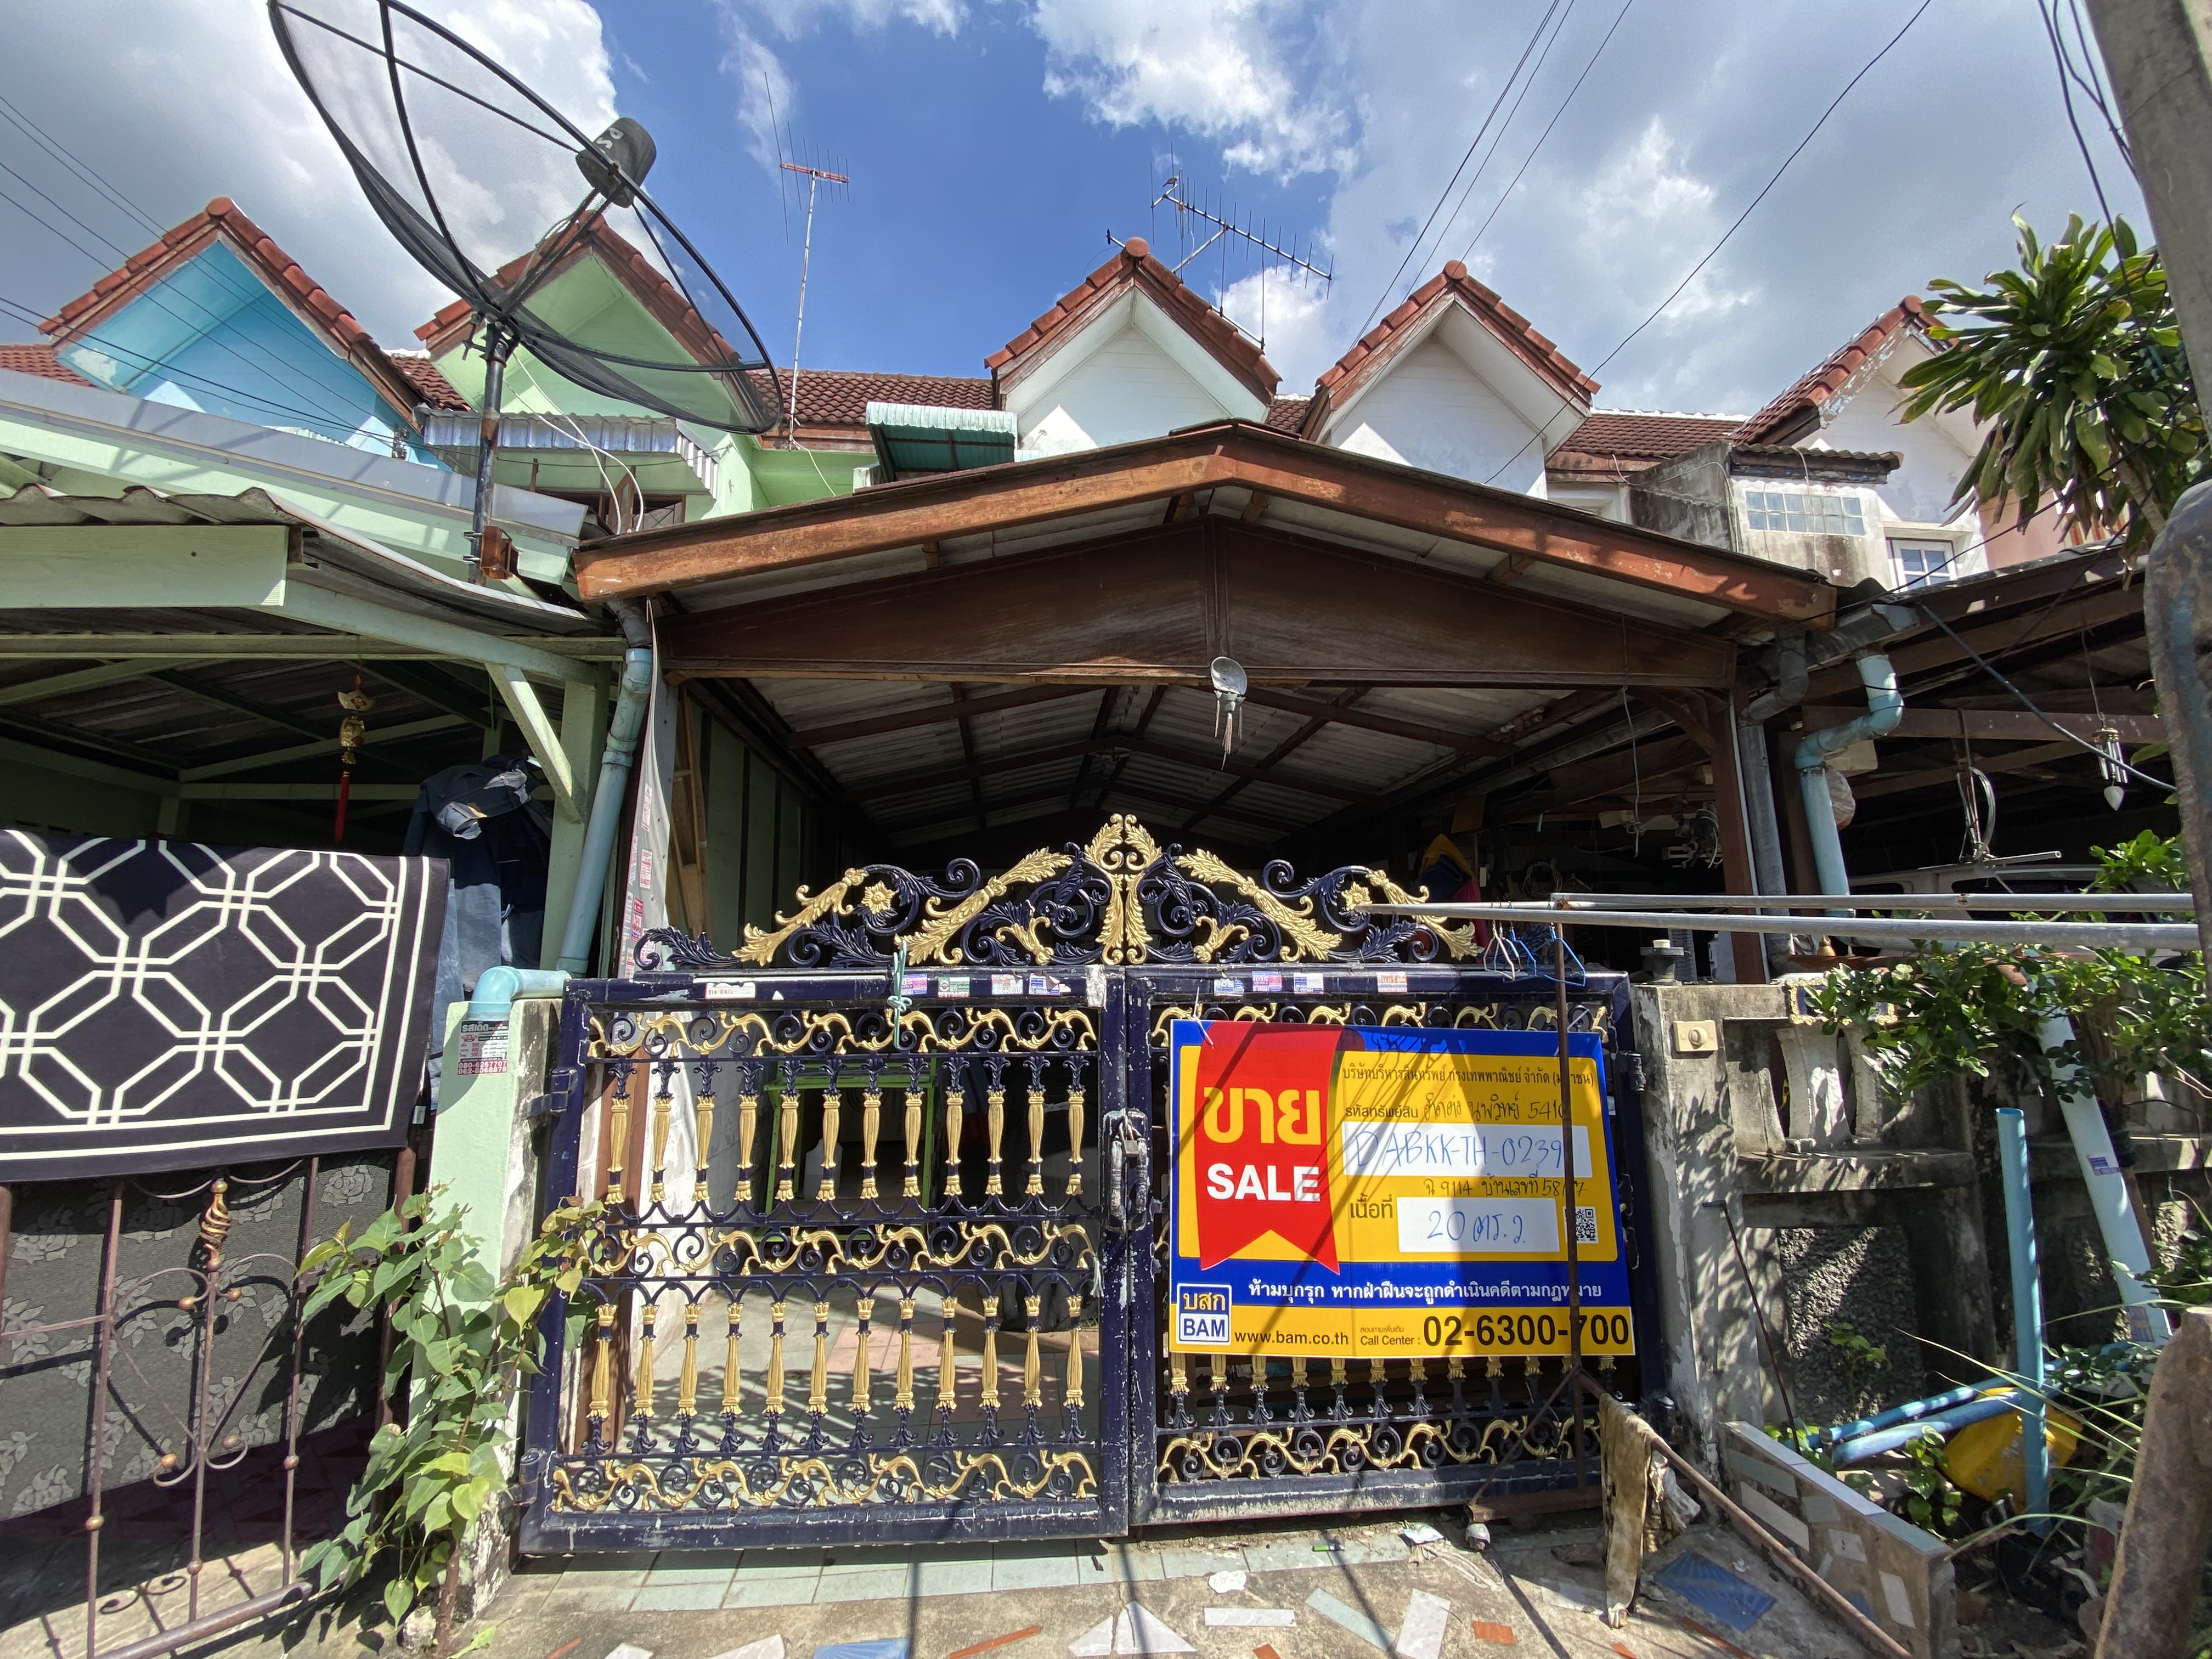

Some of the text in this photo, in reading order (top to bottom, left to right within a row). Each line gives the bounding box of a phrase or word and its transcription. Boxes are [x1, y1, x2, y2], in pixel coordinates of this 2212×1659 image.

[1342, 1062, 1594, 1087] บริษัทบริหารสินทรัพย์ กรุงเทพพาณิชย์ จำกัด (มาชน)
[1203, 1086, 1322, 1146] ขาย
[1345, 1103, 1419, 1119] รหัสทรัพย์สิน
[1206, 1163, 1322, 1202] SALE
[1350, 1190, 1393, 1219] เนื้อที่
[1427, 1210, 1466, 1242] 20
[1182, 1291, 1226, 1312] บสก
[1248, 1278, 1325, 1304] ห้ามบุกรุก
[1183, 1318, 1226, 1338] BAM
[1234, 1330, 1349, 1345] www.bam.co.th
[1360, 1335, 1379, 1346] Call
[1381, 1335, 1415, 1346] Center
